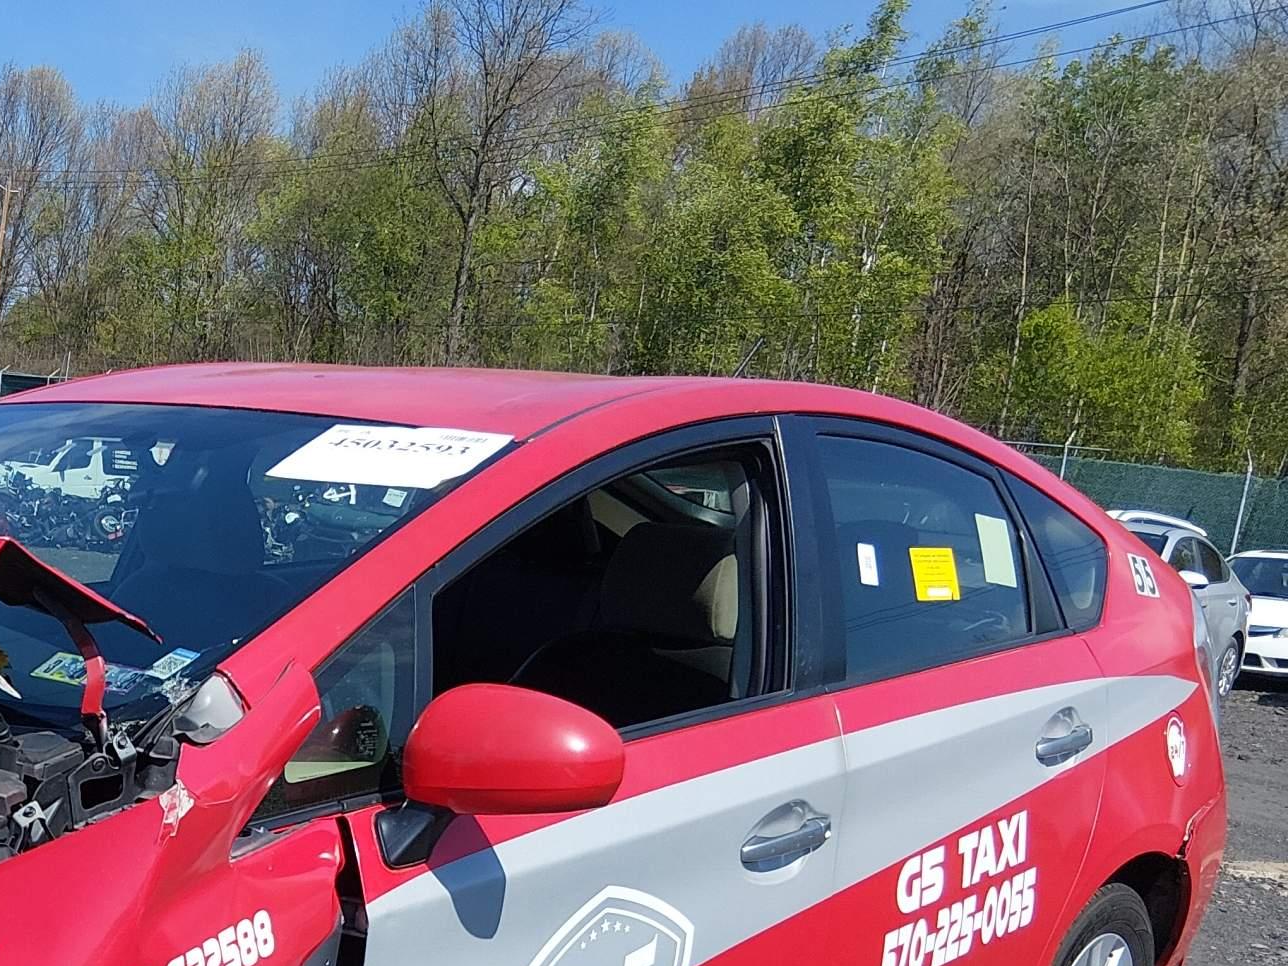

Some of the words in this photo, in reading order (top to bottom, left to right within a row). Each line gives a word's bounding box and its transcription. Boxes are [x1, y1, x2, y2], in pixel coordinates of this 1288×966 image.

[329, 437, 472, 456] 45032593
[1131, 556, 1157, 595] 55
[896, 844, 945, 914] G5
[957, 810, 1029, 889] TAXI
